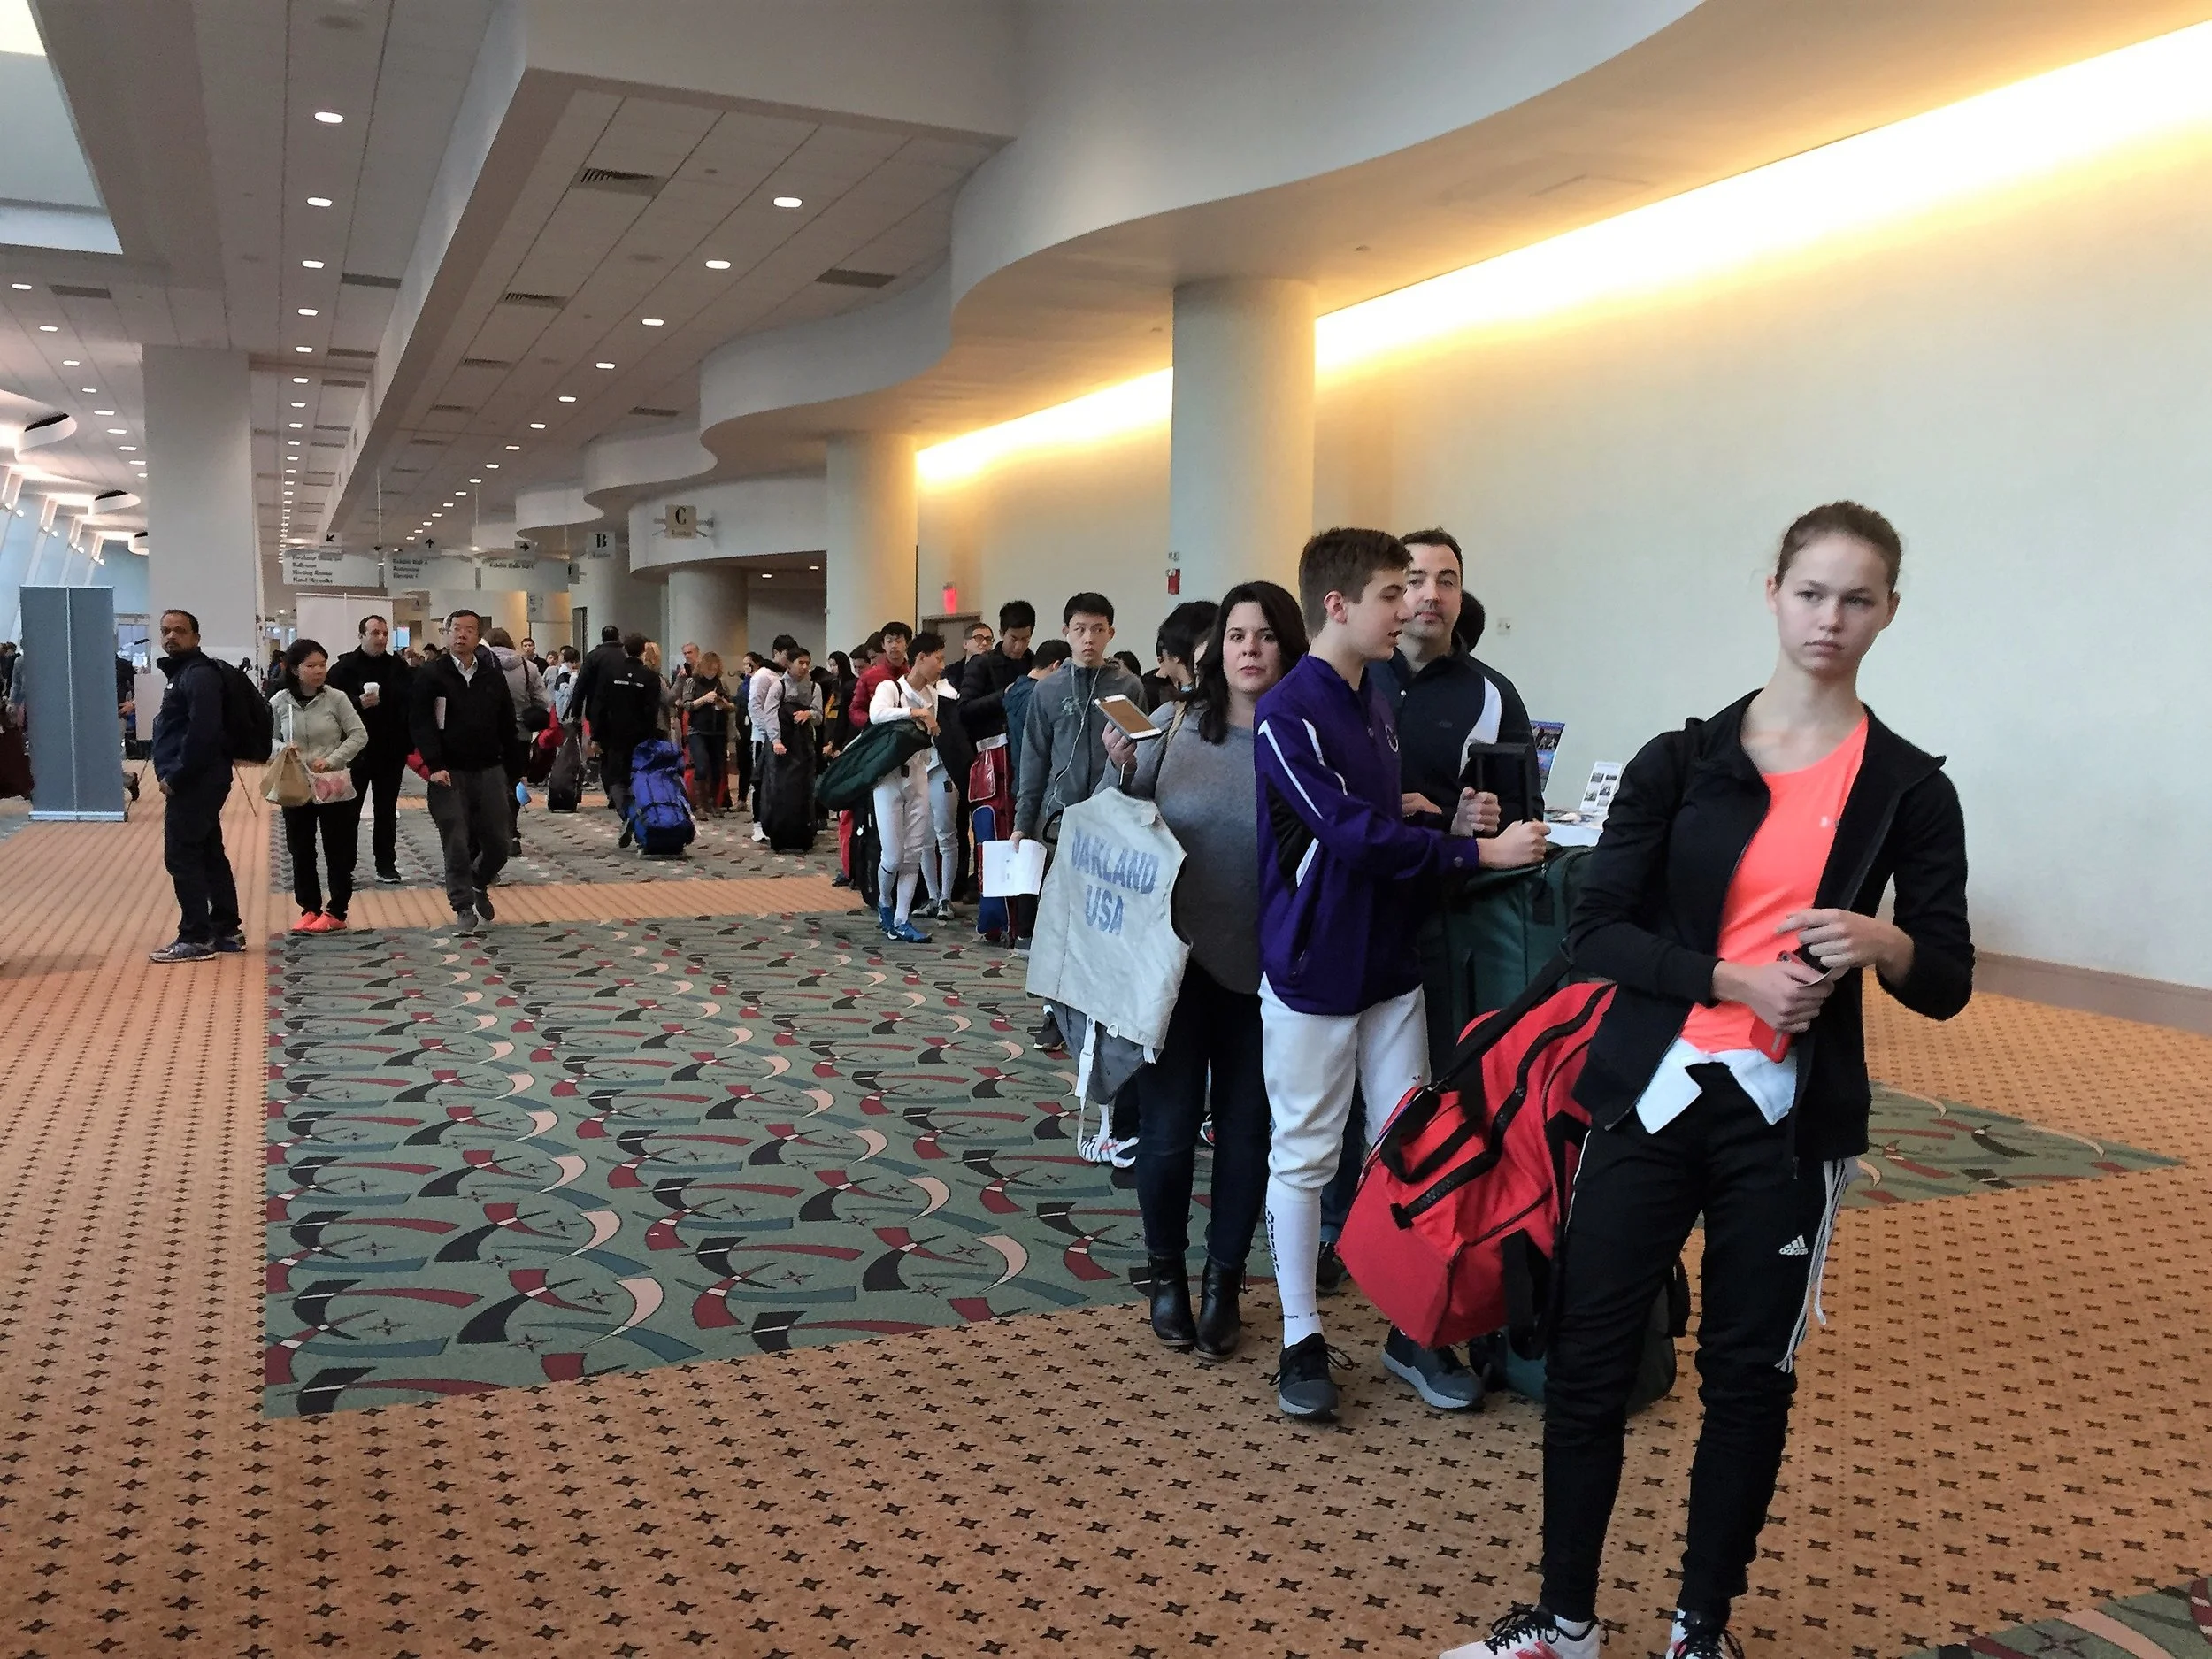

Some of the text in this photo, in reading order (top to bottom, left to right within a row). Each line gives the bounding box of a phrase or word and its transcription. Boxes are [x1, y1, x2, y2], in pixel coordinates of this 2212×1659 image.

[675, 506, 687, 525] C
[595, 533, 607, 548] B
[1085, 884, 1124, 935] USA
